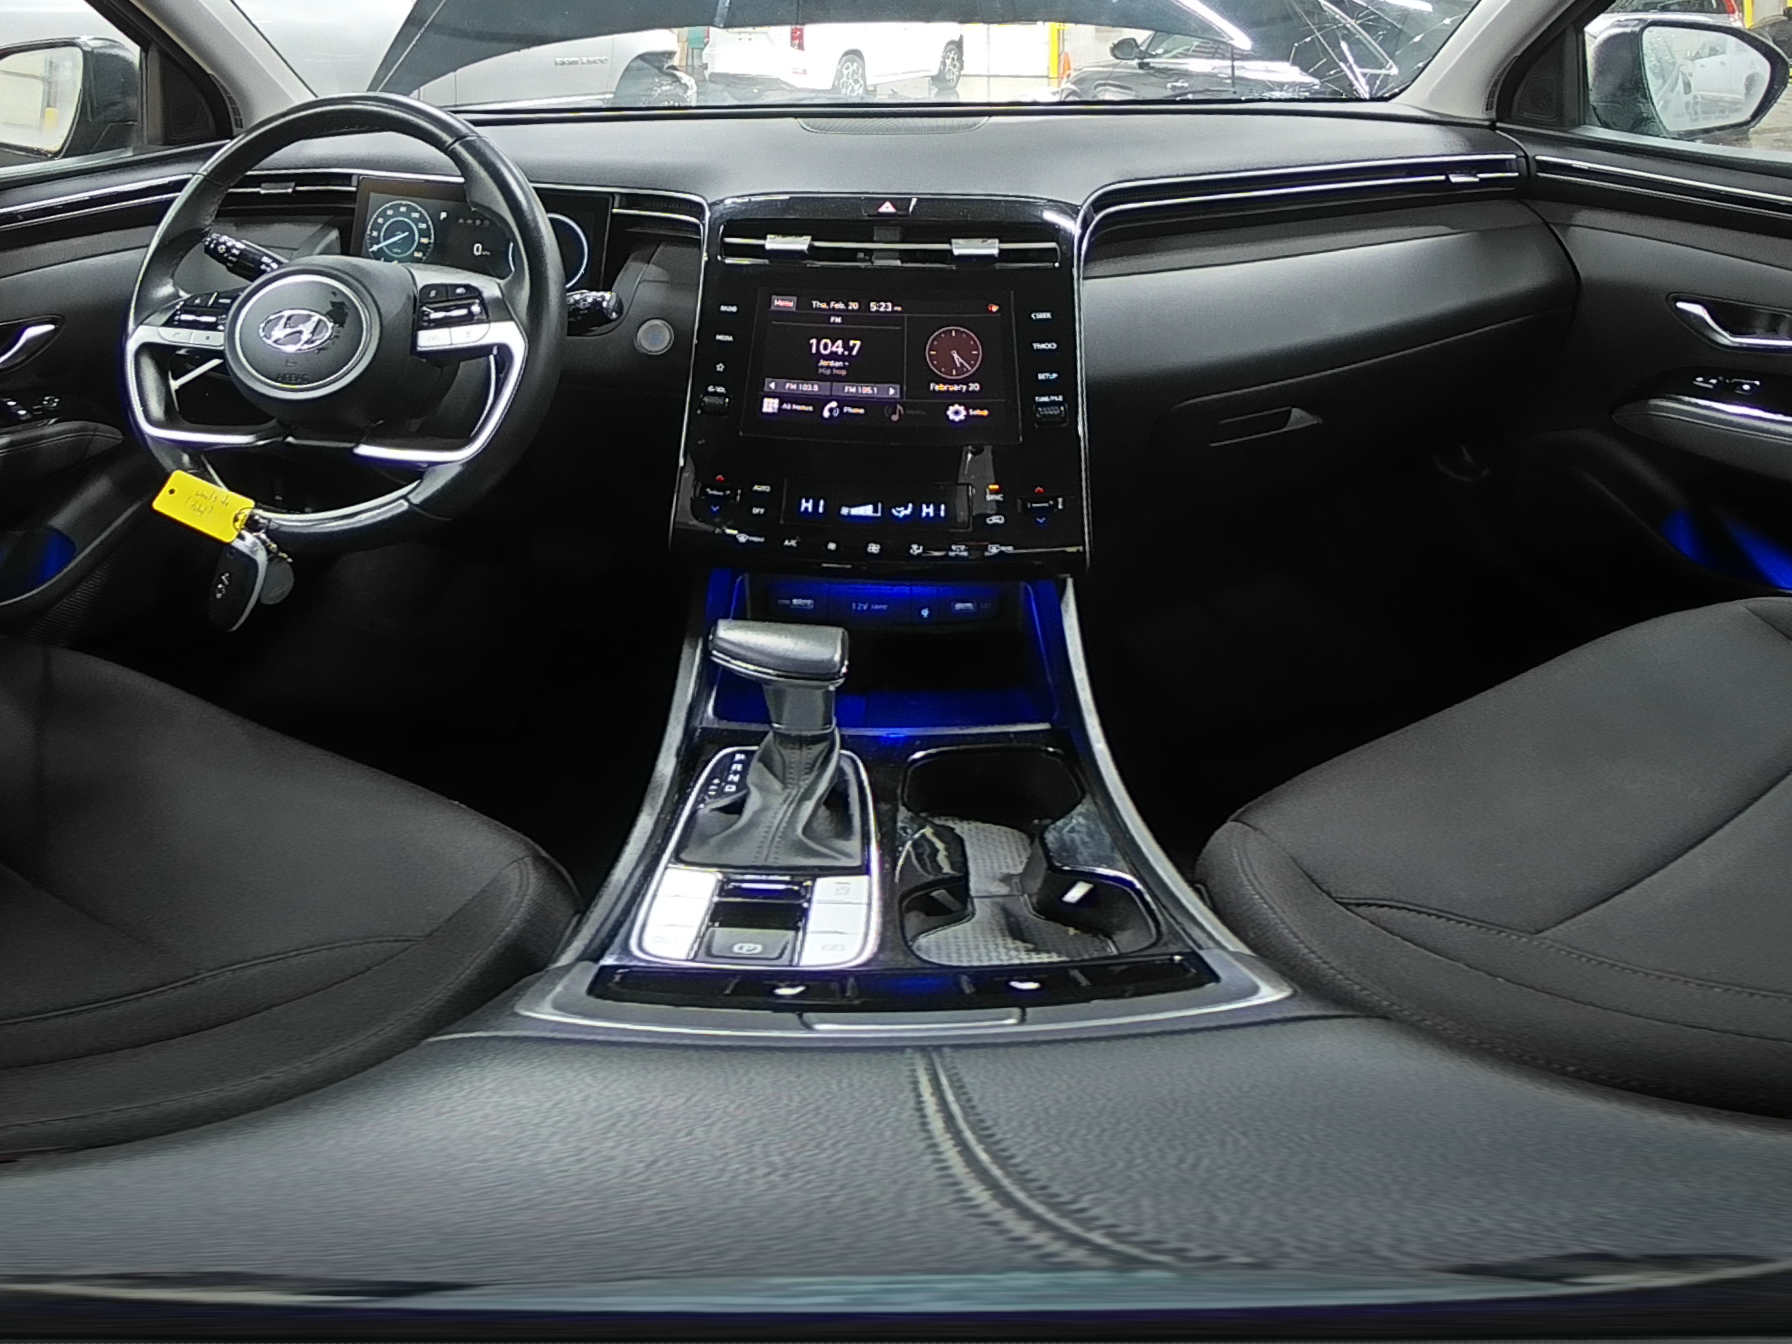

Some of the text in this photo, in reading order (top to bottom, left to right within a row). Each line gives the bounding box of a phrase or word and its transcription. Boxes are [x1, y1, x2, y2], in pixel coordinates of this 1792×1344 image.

[848, 301, 859, 310] 20
[869, 301, 892, 312] 5:23
[830, 316, 842, 324] FM
[809, 338, 862, 356] 104.7
[785, 382, 797, 390] FM
[929, 382, 981, 394] February 20
[843, 406, 865, 414] Phone
